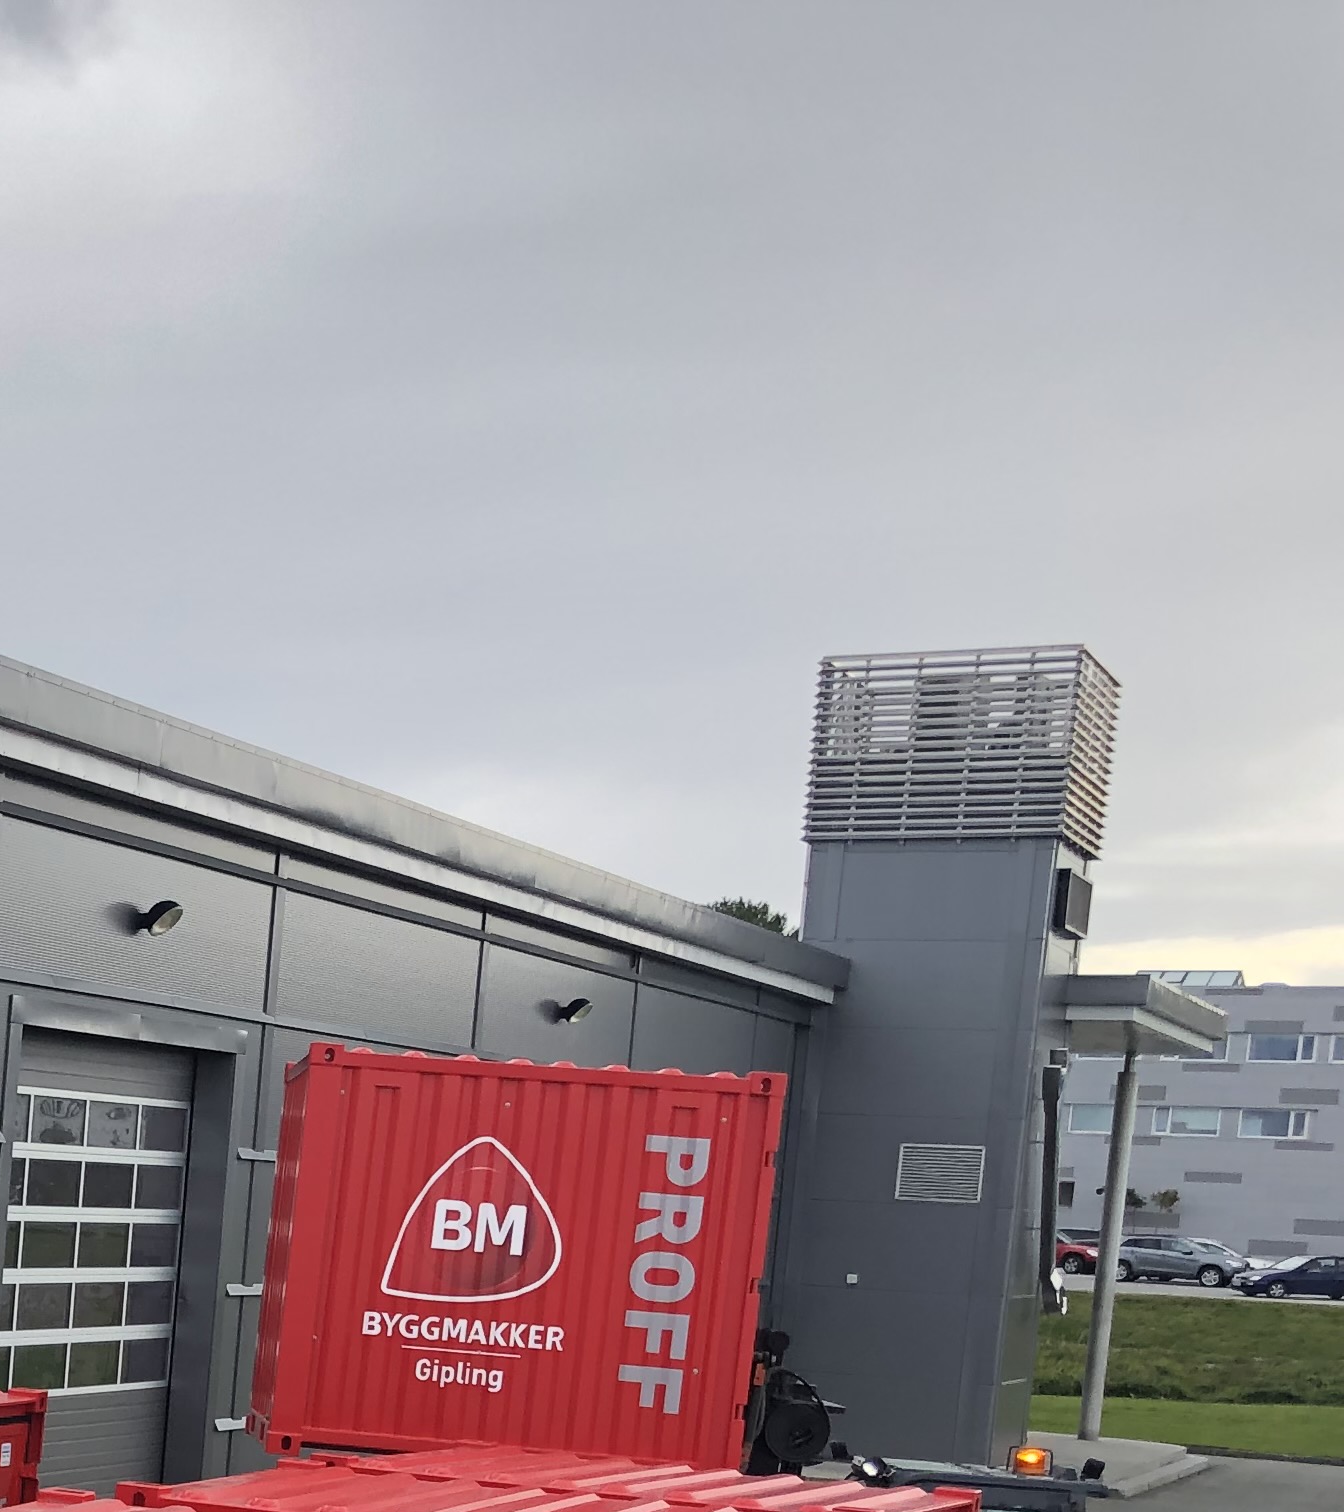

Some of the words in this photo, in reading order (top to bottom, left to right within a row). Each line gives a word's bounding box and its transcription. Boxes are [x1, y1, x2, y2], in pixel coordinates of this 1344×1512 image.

[429, 1198, 528, 1256] BM
[617, 1134, 711, 1415] PROFF
[361, 1311, 565, 1352] BYGGMAKKER
[415, 1358, 504, 1392] Gipling
